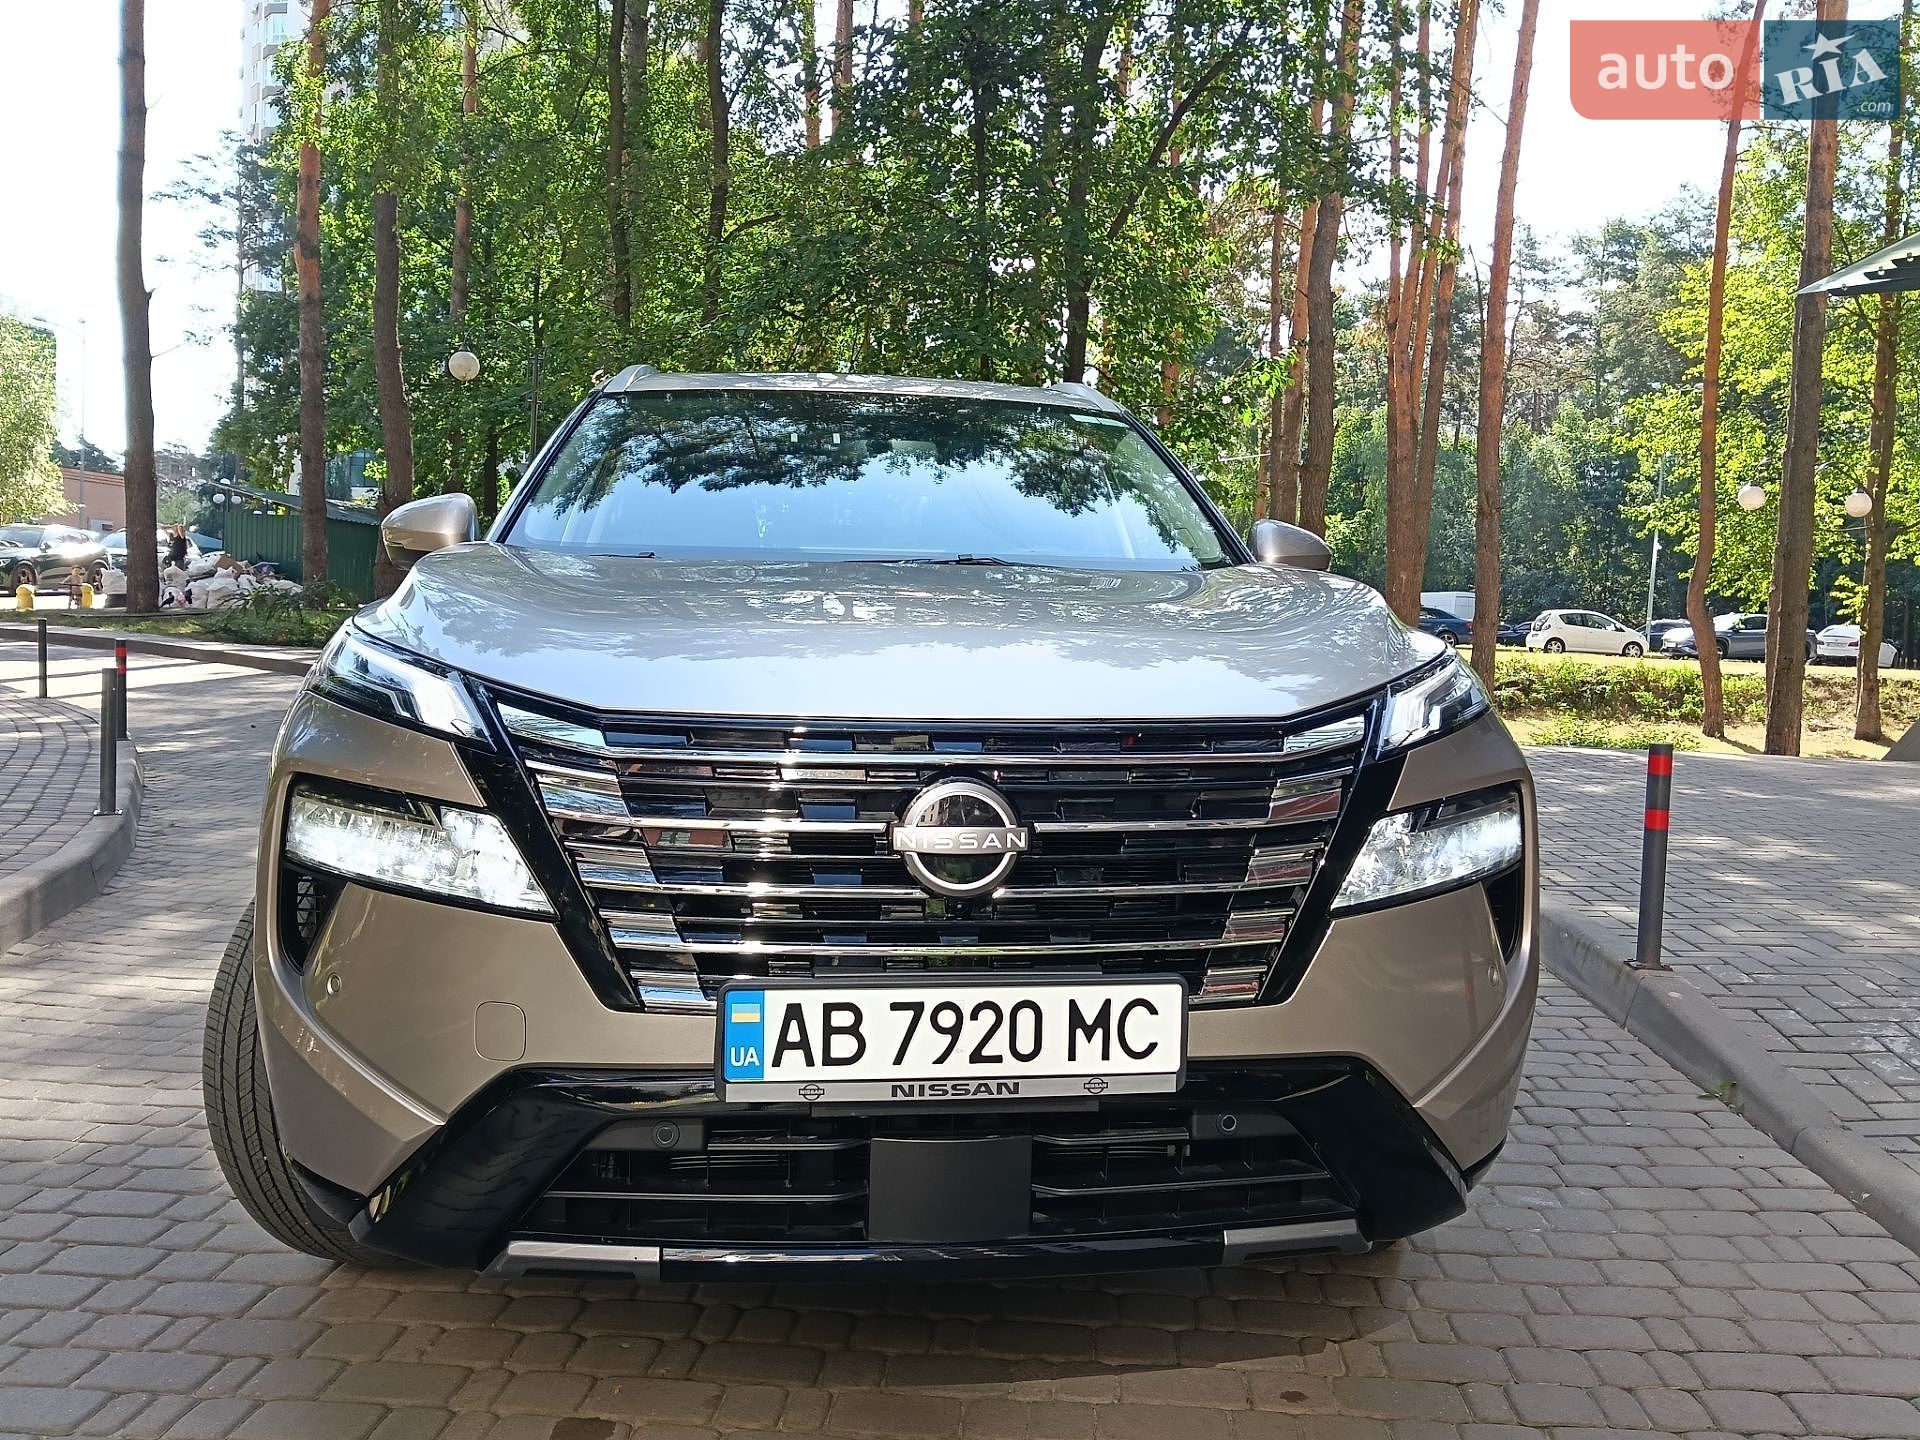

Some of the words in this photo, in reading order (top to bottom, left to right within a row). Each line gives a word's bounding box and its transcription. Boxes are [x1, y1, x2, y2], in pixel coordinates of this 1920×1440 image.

[896, 832, 1025, 849] NISSAN
[771, 1002, 867, 1068] AB
[889, 1000, 1042, 1066] 7920
[1067, 998, 1159, 1062] MC
[730, 1046, 760, 1067] UA
[891, 1081, 1020, 1098] NISSAN
